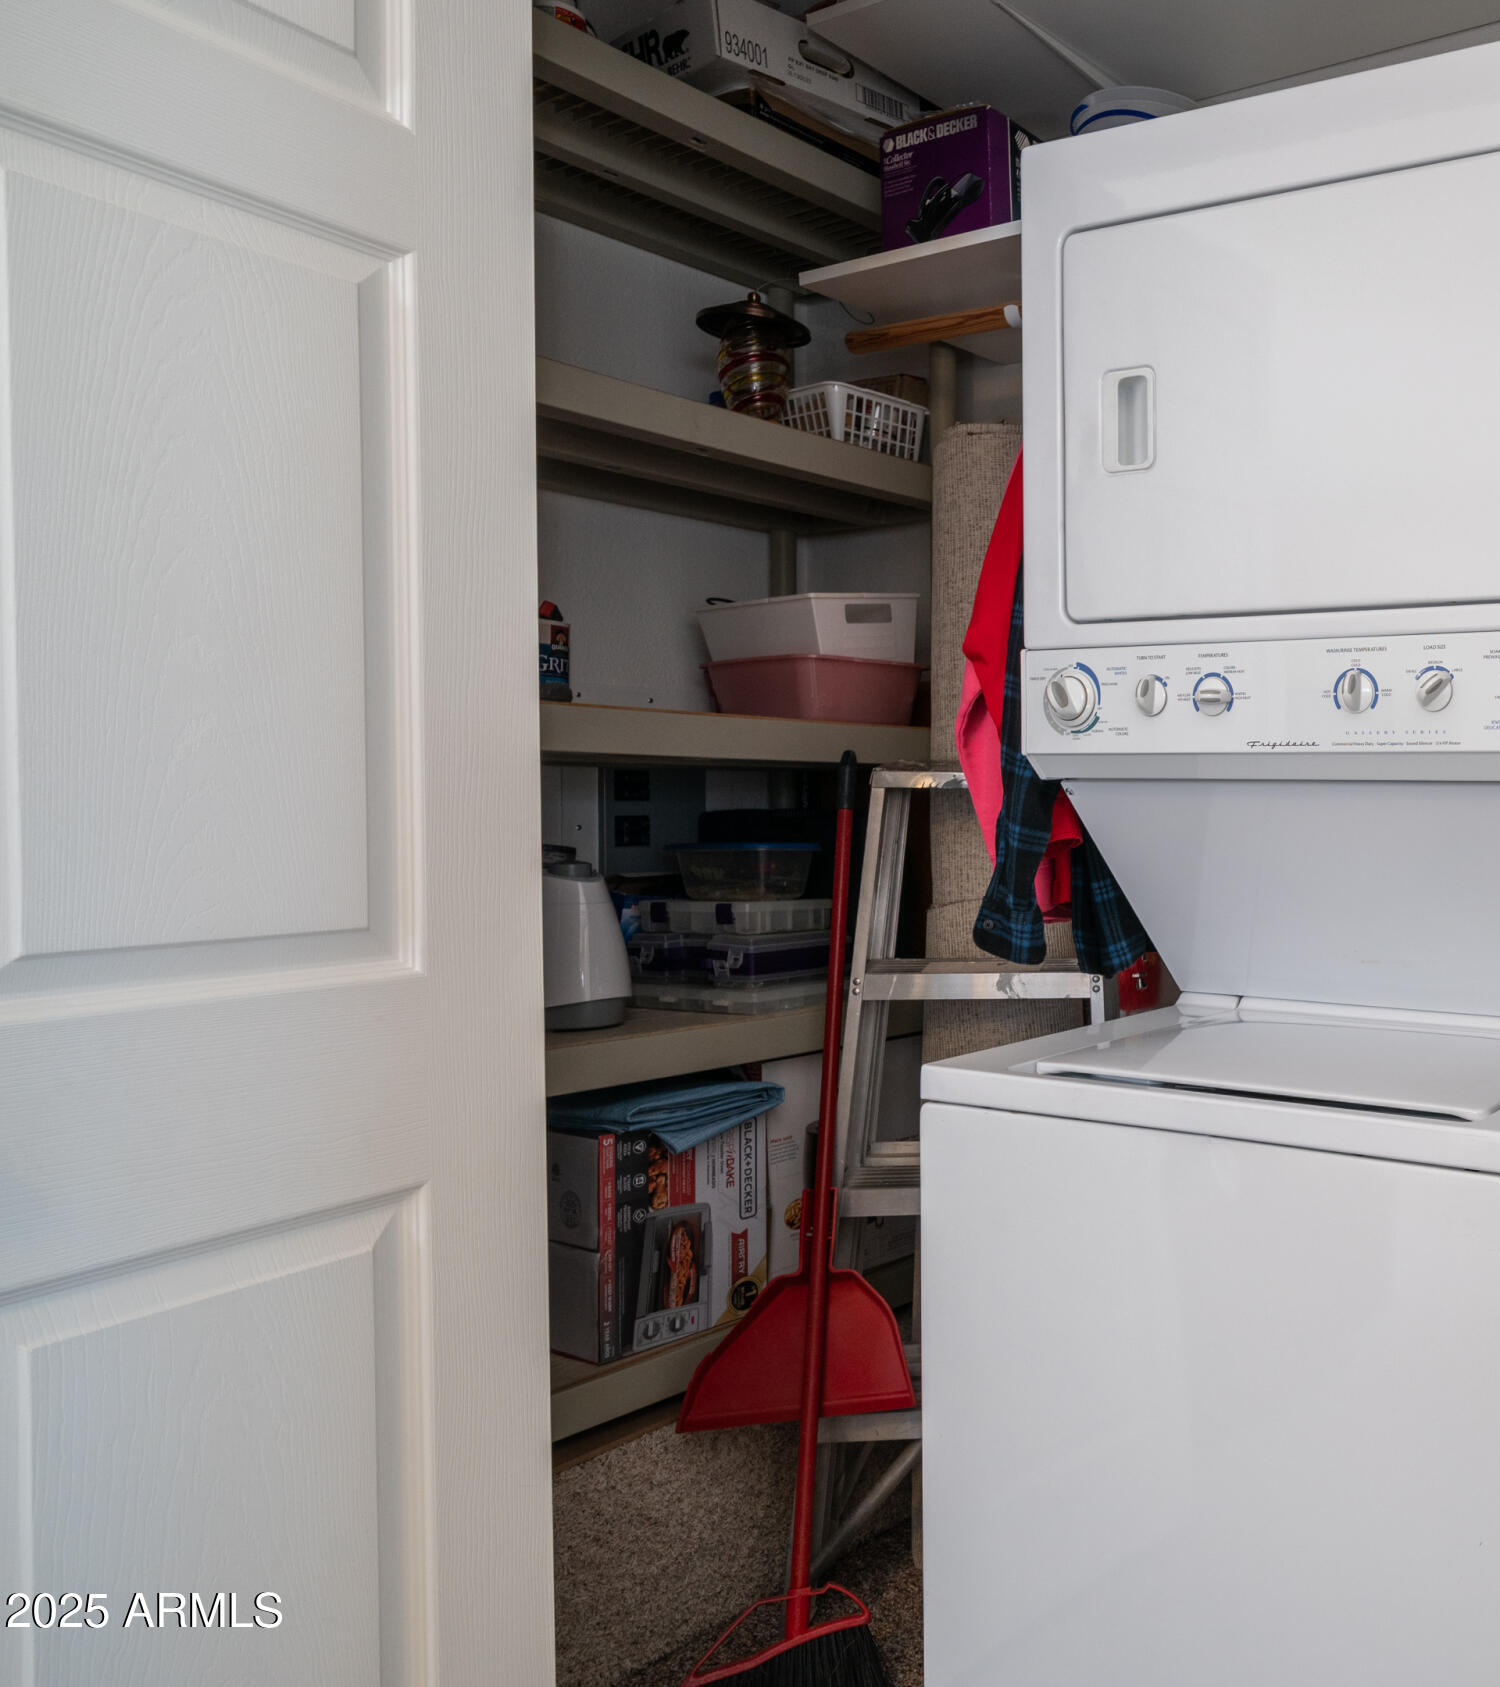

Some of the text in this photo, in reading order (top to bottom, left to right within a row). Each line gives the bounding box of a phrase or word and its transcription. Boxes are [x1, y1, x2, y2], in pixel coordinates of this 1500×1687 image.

[725, 31, 768, 68] 934001
[1246, 739, 1320, 750] Frigidaire
[603, 1138, 613, 1146] 5
[743, 1122, 753, 1214] BLACK+DECKER
